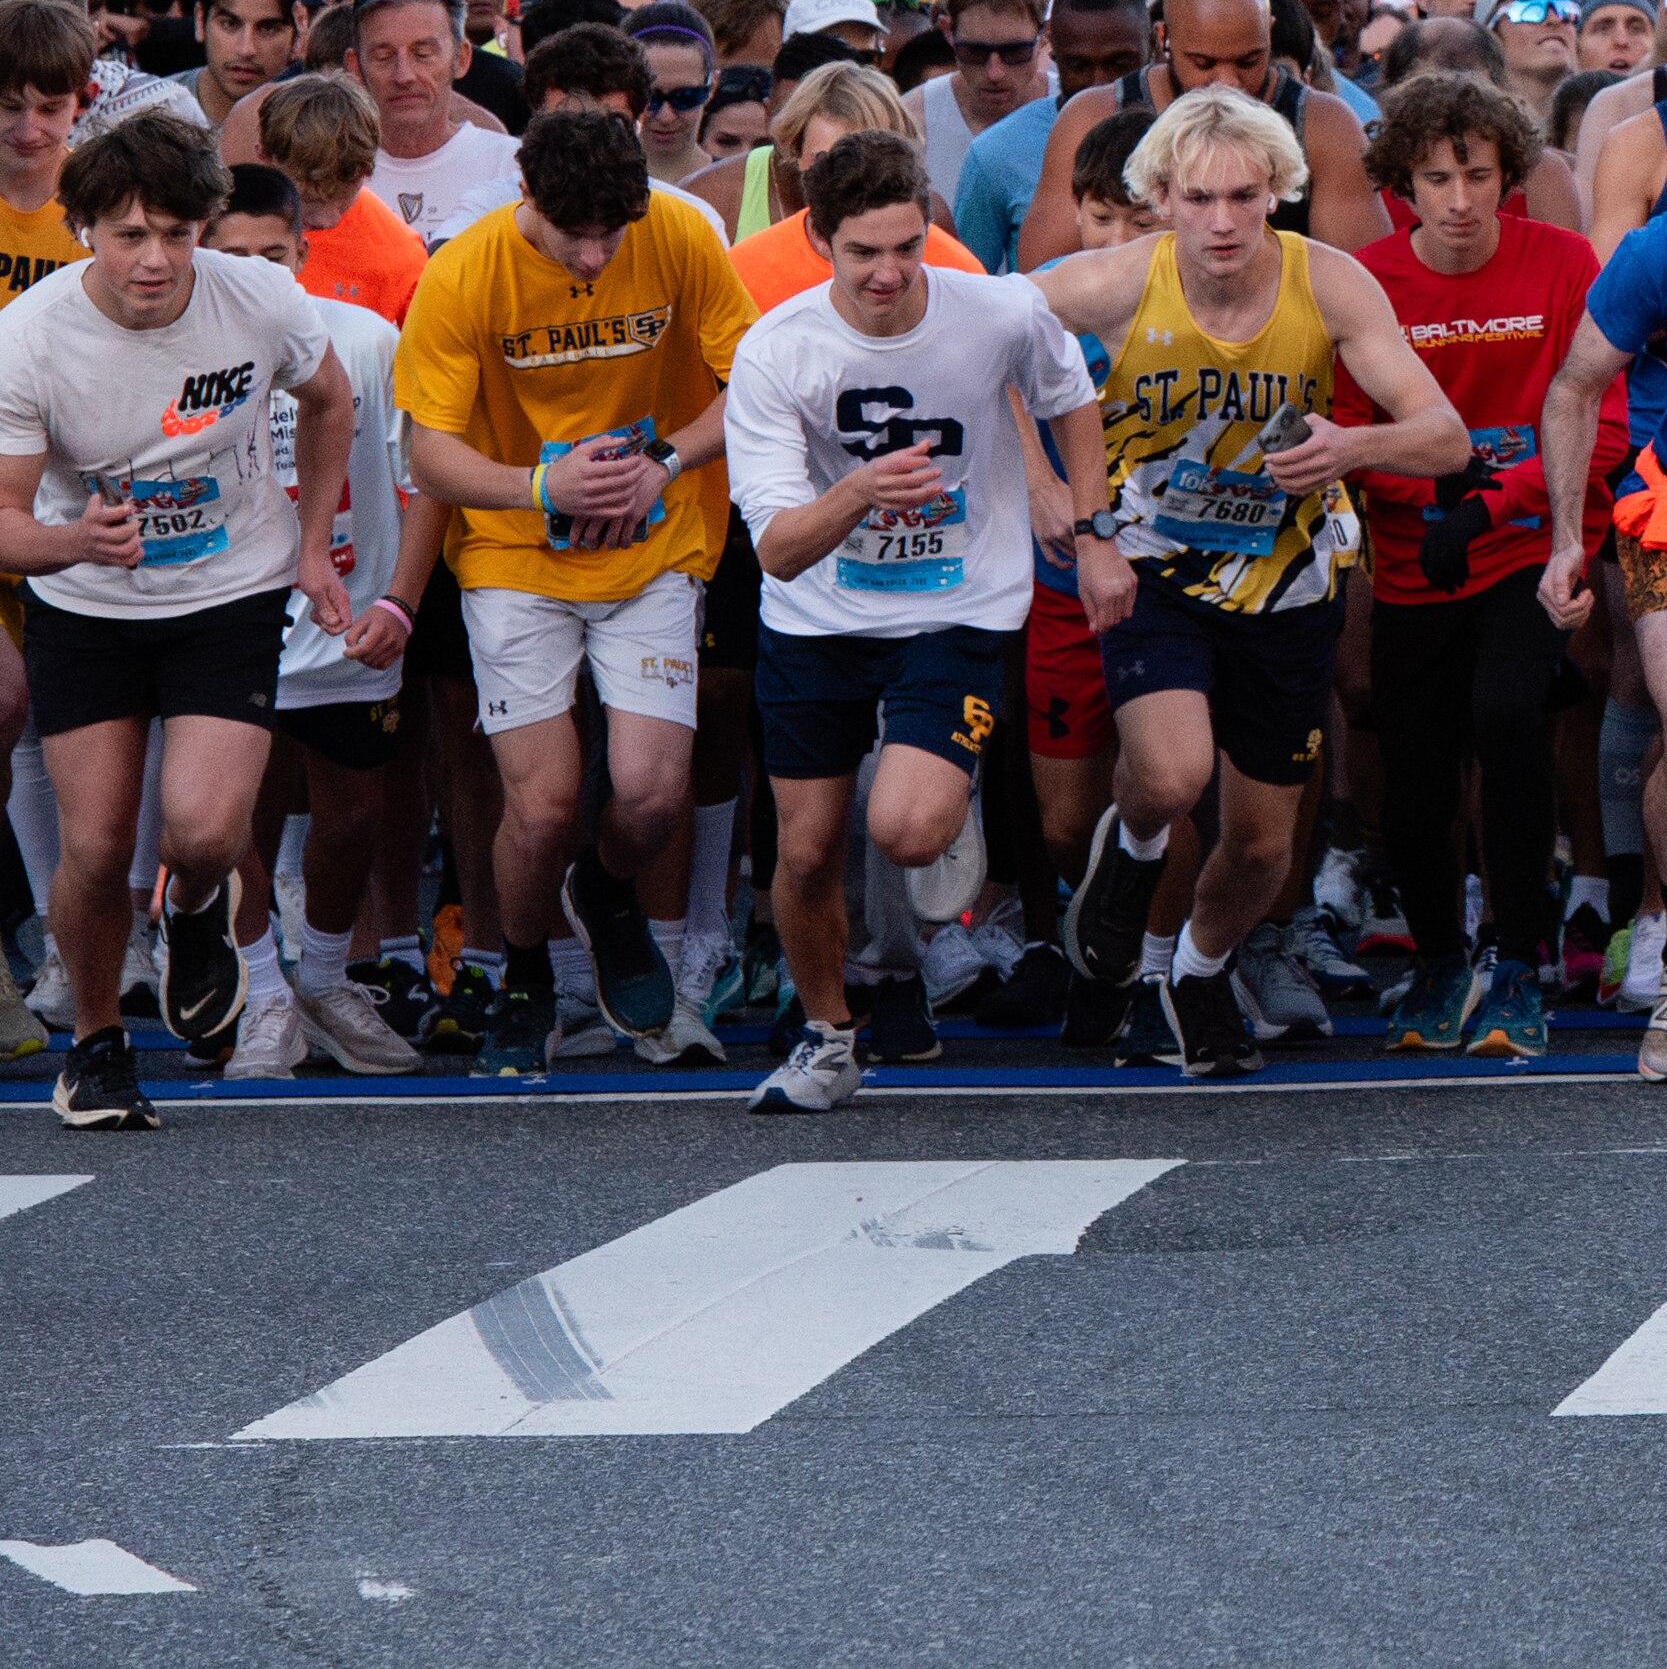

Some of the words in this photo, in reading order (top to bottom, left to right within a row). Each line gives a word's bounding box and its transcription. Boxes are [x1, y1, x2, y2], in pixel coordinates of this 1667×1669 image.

[502, 335, 537, 358] ST.
[547, 319, 627, 353] PAUL'S
[1411, 315, 1544, 341] BALTIMORE
[178, 361, 255, 412] NIKE
[1135, 368, 1185, 424] ST.
[138, 509, 206, 538] 7502
[1198, 498, 1267, 525] 7680
[877, 531, 945, 560] 7155
